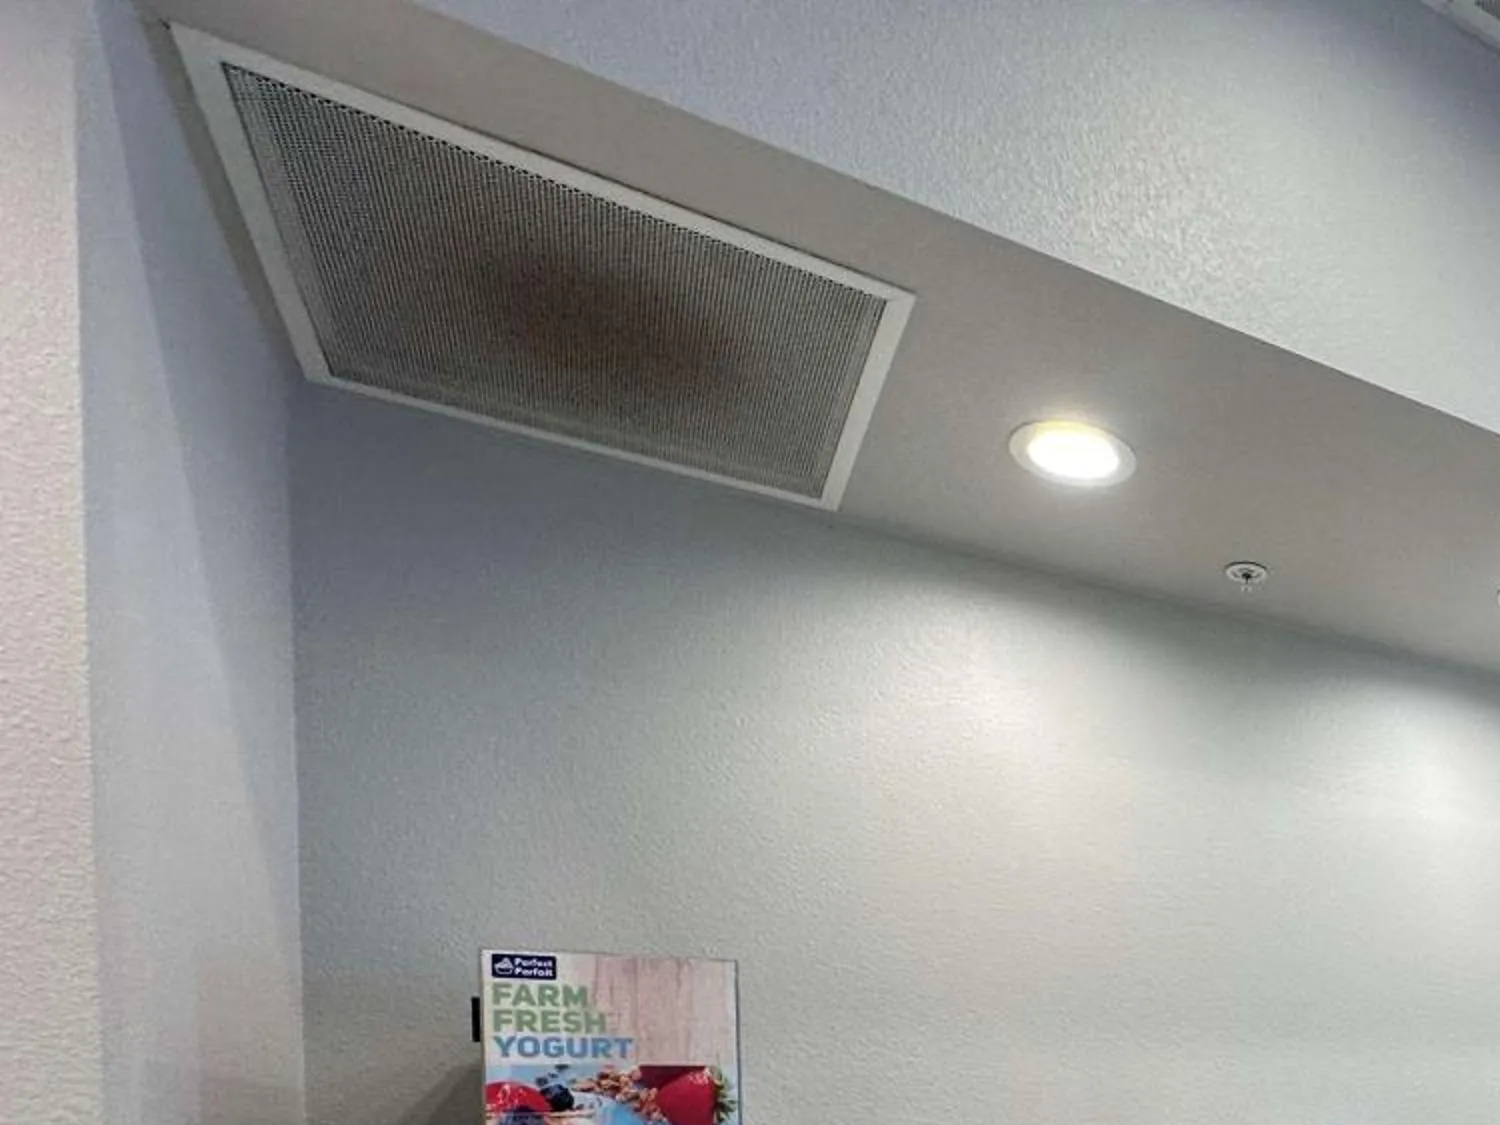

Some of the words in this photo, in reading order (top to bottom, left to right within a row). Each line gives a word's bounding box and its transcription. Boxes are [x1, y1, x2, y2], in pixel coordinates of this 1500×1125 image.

[492, 984, 588, 1007] FARM
[492, 1010, 606, 1034] FRESH
[493, 1036, 633, 1059] YOGURT
